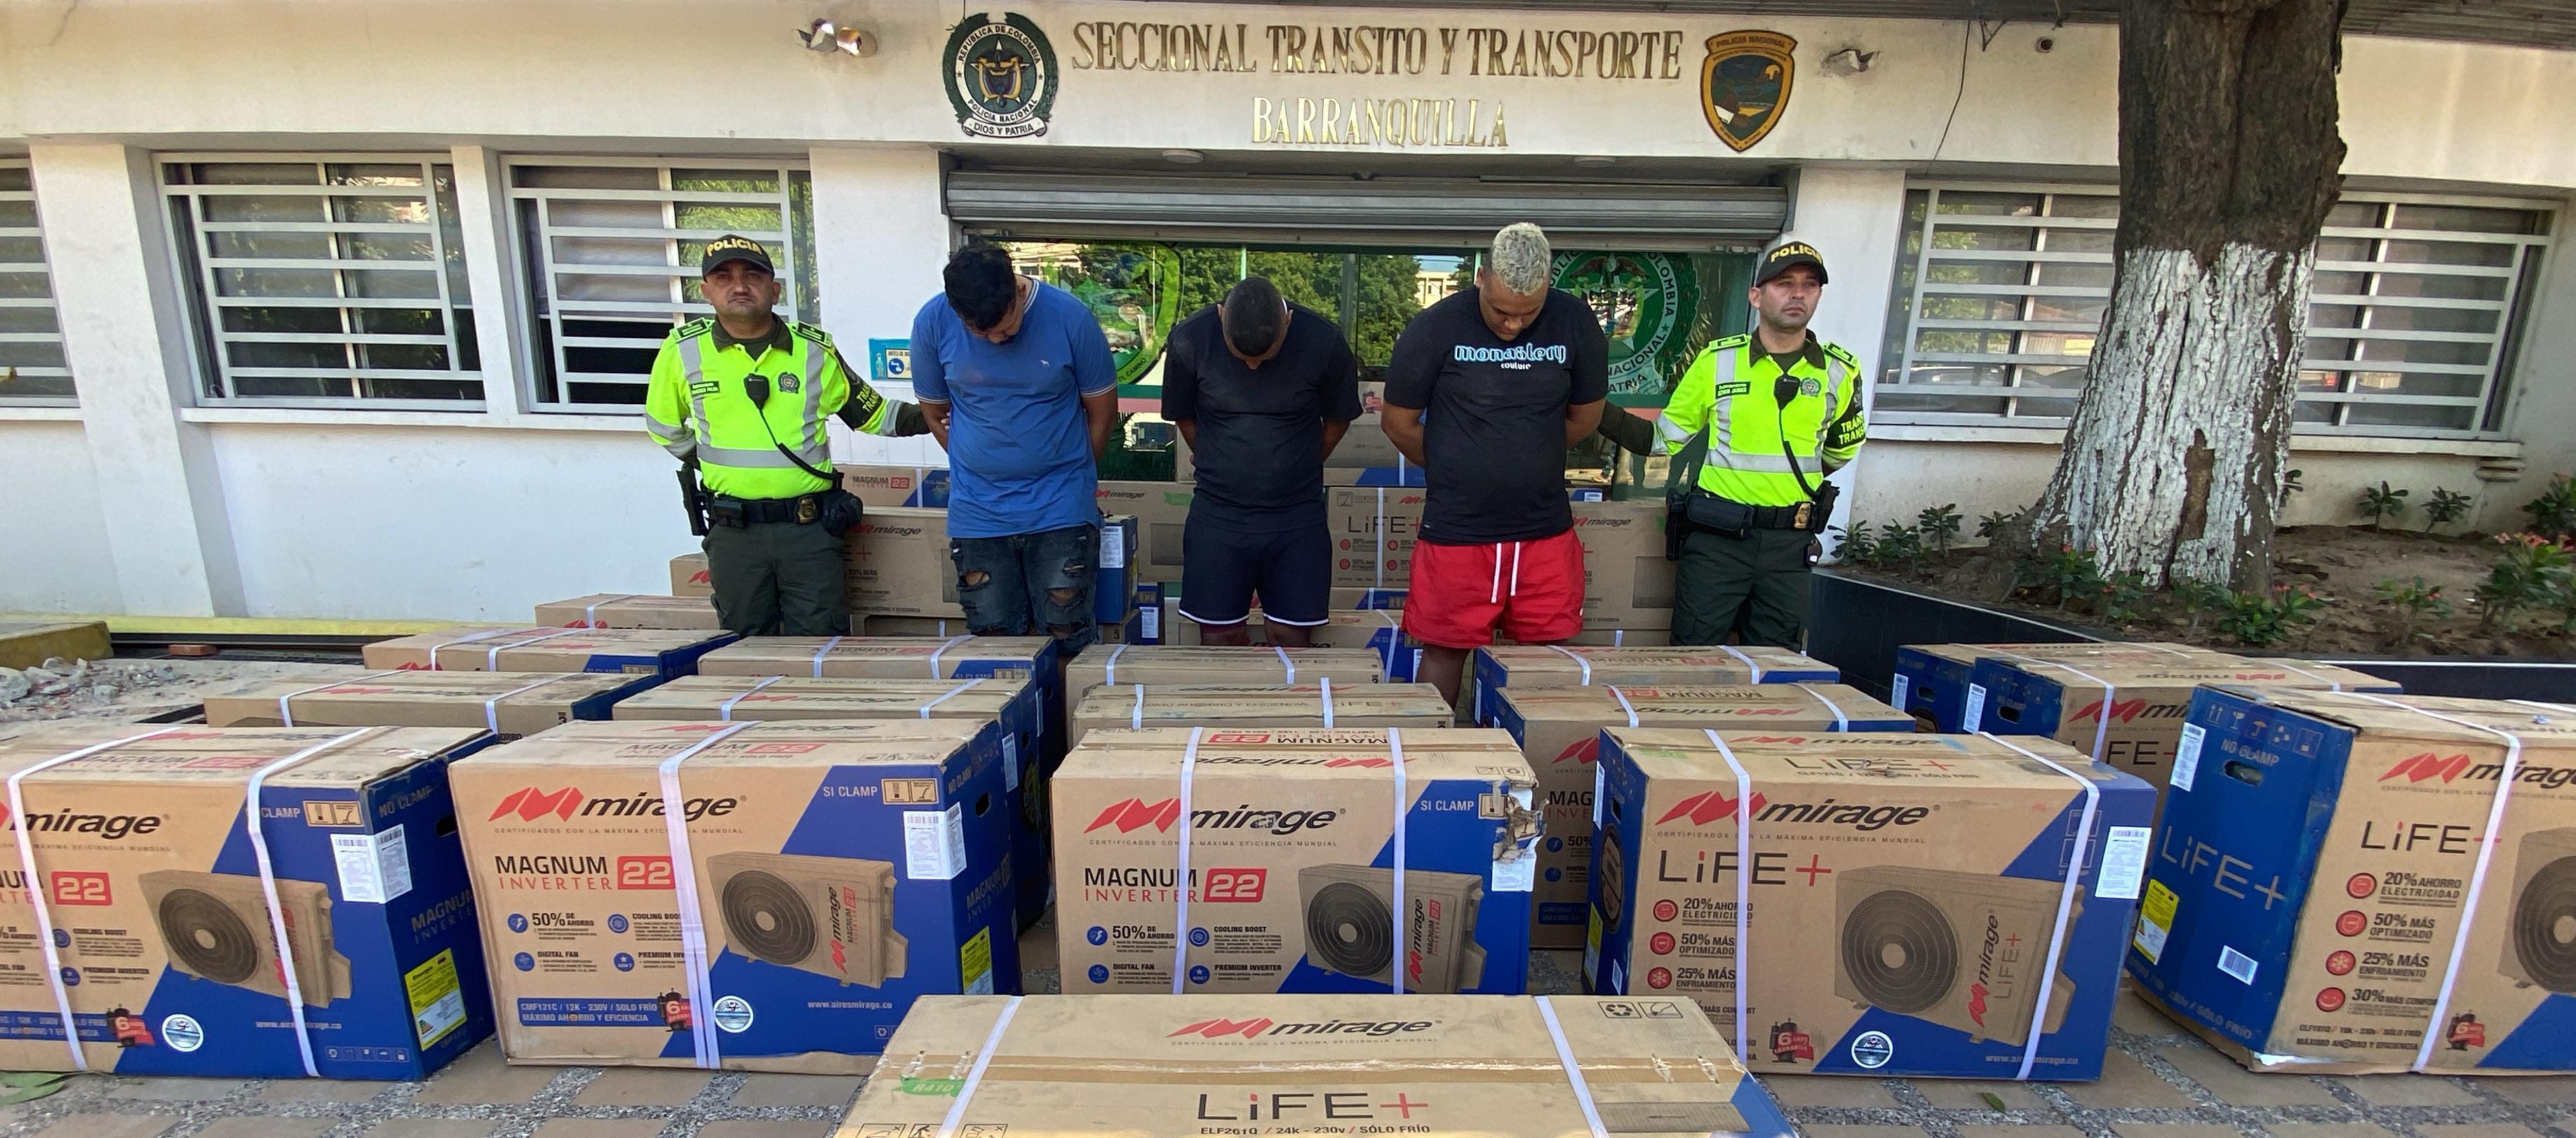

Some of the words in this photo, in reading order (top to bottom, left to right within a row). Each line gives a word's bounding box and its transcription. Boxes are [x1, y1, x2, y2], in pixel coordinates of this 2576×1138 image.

[995, 25, 1006, 34] DE
[1007, 27, 1041, 65] COLOMBIA
[1072, 22, 1256, 72] SECCIONAL
[1266, 25, 1426, 75] TRANSITO
[1440, 28, 1459, 75] Y
[1467, 29, 1684, 80] TRANSPORTE
[967, 99, 996, 121] POLICIA
[1000, 99, 1038, 122] NACIONAL
[974, 122, 994, 135] DIOS
[1005, 123, 1034, 135] PATRIA
[1253, 97, 1509, 148] BARRANQUILLA
[706, 238, 762, 257] POLICIA
[1648, 252, 1675, 316] OLOMBIA
[1126, 358, 1147, 378] CAMINO
[1609, 375, 1646, 393] ATRIA
[852, 476, 889, 484] MAGNUM
[892, 478, 909, 489] 22
[873, 524, 922, 536] mirage
[1586, 518, 1631, 528] mirage
[2221, 739, 2237, 754] NO
[2239, 744, 2279, 766] CLAMP
[823, 786, 836, 797] SI
[839, 786, 878, 798] CLAMP
[378, 801, 395, 817] NO
[398, 786, 433, 809] CLAMP
[580, 792, 737, 822] mirage
[1421, 801, 1433, 811] SI
[1435, 801, 1474, 811] CLAMP
[260, 807, 300, 819] CLAMP
[1190, 804, 1336, 835] mirage
[1757, 798, 1929, 831] mirage
[9, 808, 161, 840] mirage
[495, 856, 608, 874] MAGNUM
[623, 862, 671, 885] 22
[1658, 850, 1832, 887] LiFE+
[2161, 825, 2285, 911] LiFE+
[499, 877, 612, 890] INVERTER
[1210, 873, 1261, 898] 22
[2384, 872, 2417, 885] 20%
[2419, 878, 2461, 888] AHORRO
[58, 876, 106, 901] 22
[2381, 886, 2460, 899] ELECTRICIDAD
[1684, 897, 1713, 910] 20%
[532, 913, 565, 926] 50%
[829, 886, 841, 942] mirage
[2374, 913, 2407, 927] 50%
[2410, 916, 2434, 928] MÁS
[1112, 925, 1146, 939] 50%
[1411, 899, 1425, 953] mirage
[2370, 927, 2432, 939] OPTIMIZADO
[1681, 934, 1710, 945] 50%
[1712, 935, 1735, 946] MÁS
[1679, 946, 1735, 956] OPTIMIZADO
[1979, 914, 1999, 986] mirage
[2363, 952, 2394, 965] 25%
[2397, 953, 2429, 968] MÁS
[1677, 968, 1705, 979] 25%
[1708, 968, 1736, 980] MÁS
[2359, 966, 2427, 977] ENFRIAMIENTO
[1676, 980, 1736, 989] ENFRIAMIENTO
[2352, 988, 2384, 1002] 30%
[666, 1001, 680, 1015] 6
[116, 1017, 129, 1030] 6
[1268, 1019, 1433, 1037] mirage
[1778, 1033, 1792, 1045] 6
[1198, 1092, 1428, 1120] LiFE+
[1200, 1127, 1258, 1135] ELF261Q
[1276, 1126, 1300, 1134] 24k
[1314, 1126, 1346, 1134] 230v
[1360, 1124, 1395, 1134] SÓLO
[1400, 1124, 1430, 1134] FRÍO
